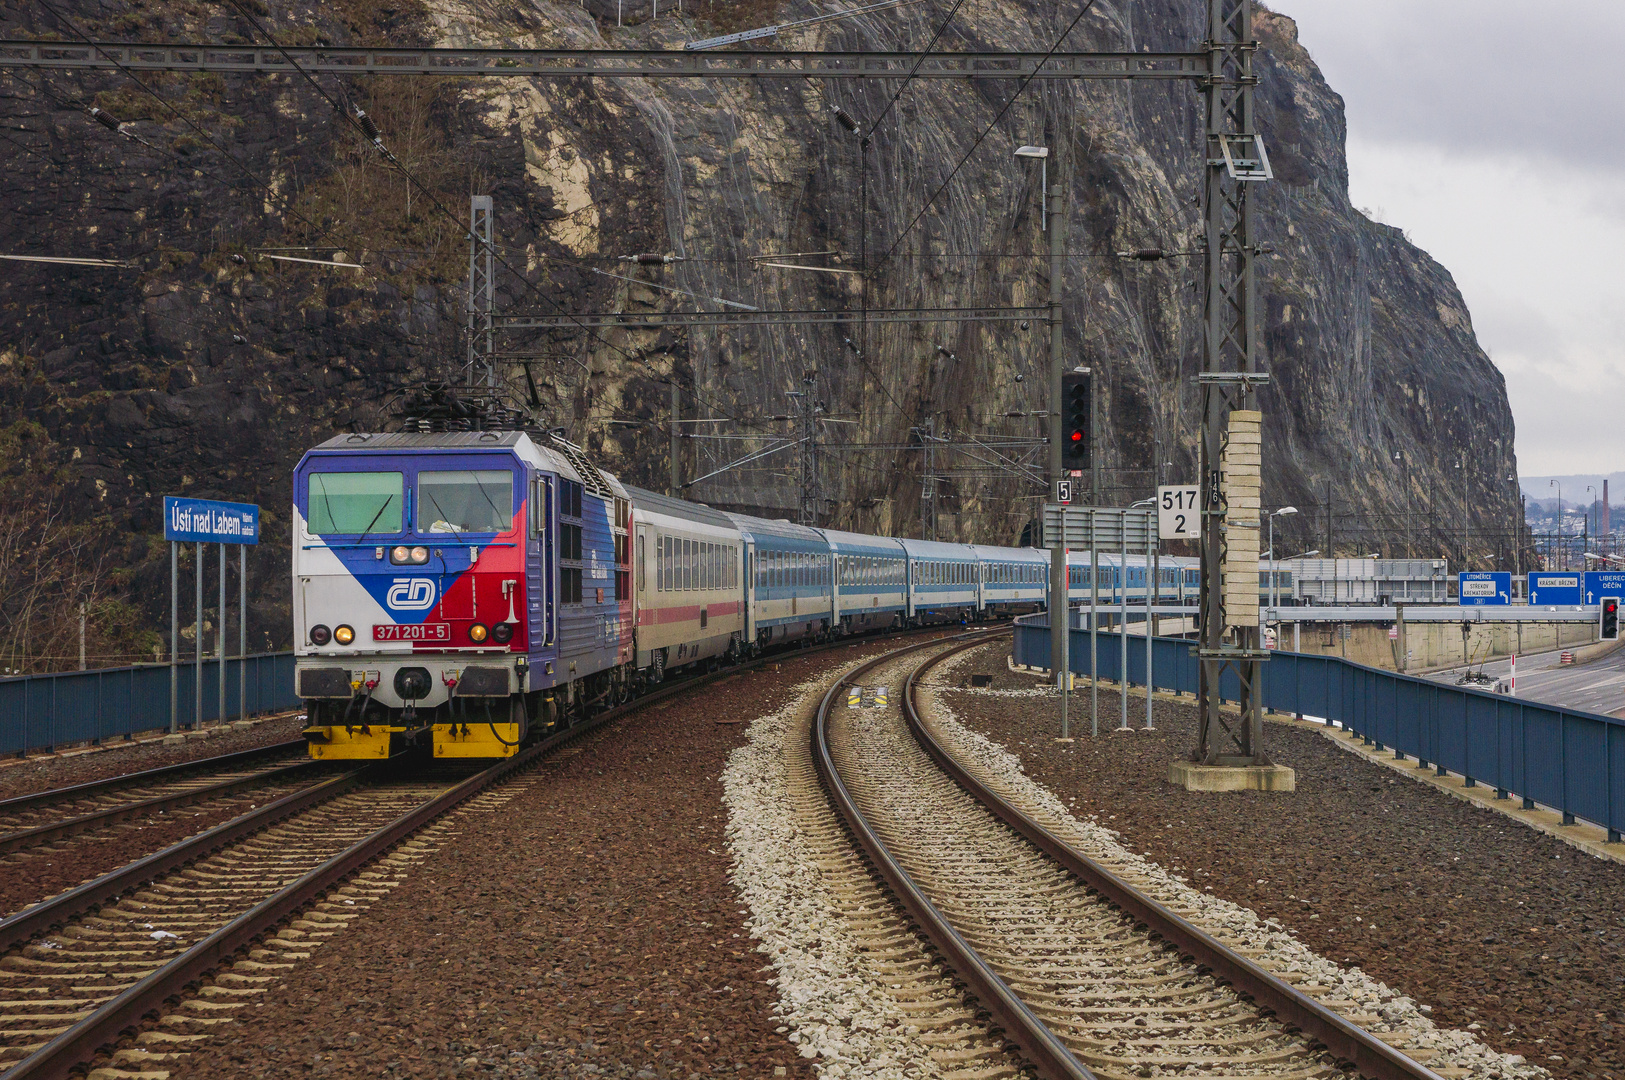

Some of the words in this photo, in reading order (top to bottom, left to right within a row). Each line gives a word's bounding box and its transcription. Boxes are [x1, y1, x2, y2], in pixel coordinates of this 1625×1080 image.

[1061, 483, 1068, 499] 5
[1162, 491, 1197, 510] 517
[172, 501, 192, 532] Ústí
[193, 510, 210, 533] nad
[212, 510, 240, 535] Labem
[1175, 515, 1186, 533] 2
